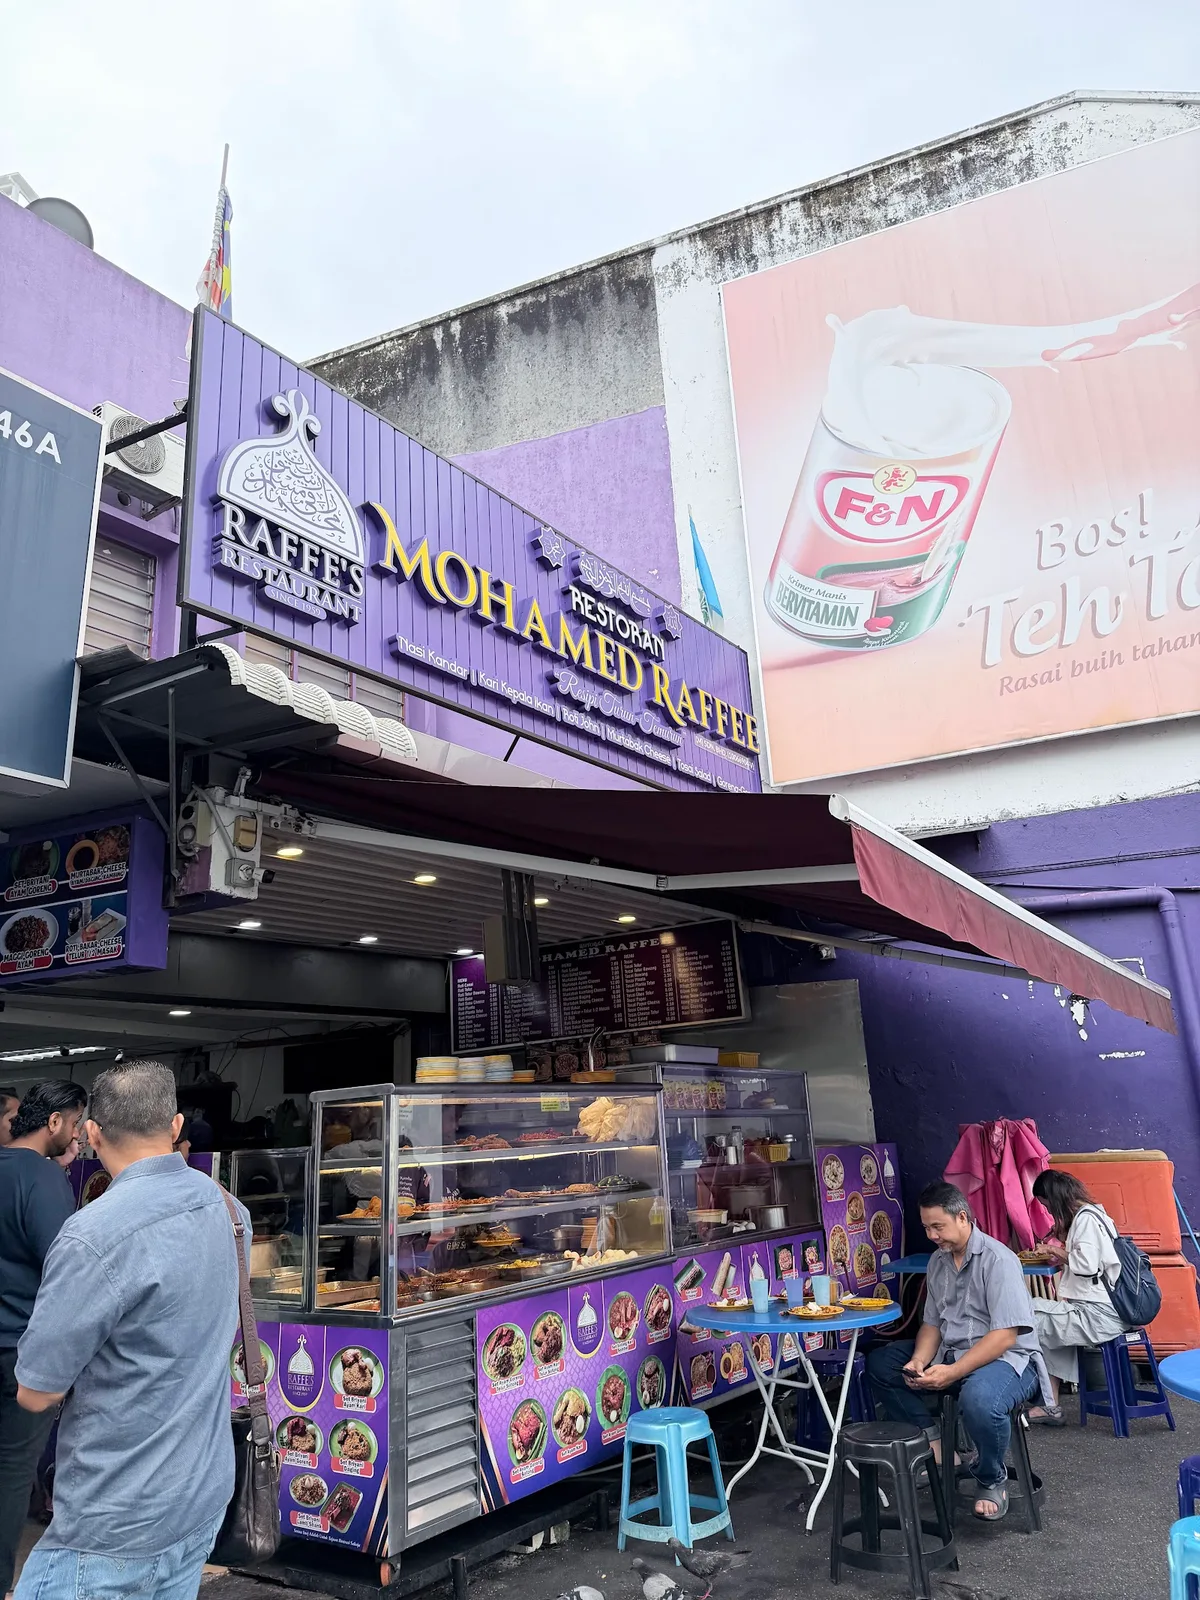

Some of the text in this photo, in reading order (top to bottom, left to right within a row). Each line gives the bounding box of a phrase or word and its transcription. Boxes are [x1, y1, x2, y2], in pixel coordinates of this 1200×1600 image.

[834, 486, 946, 526] F&N
[1035, 487, 1154, 572] Bos!
[220, 500, 365, 598] RAFFE'S
[220, 545, 364, 623] RESTAURANT
[787, 573, 847, 602] Krimer Manis
[270, 588, 322, 618] SINCE 1959
[775, 583, 860, 628] BERVITAMIN
[370, 500, 761, 755] MOHAMED RAFFEE
[568, 584, 666, 663] RESTORAN
[958, 575, 1128, 670] Teh
[999, 662, 1063, 697] Rasai
[1070, 650, 1125, 678] buih
[398, 635, 426, 658] Nasi
[427, 650, 470, 679] Kandar
[477, 672, 500, 691] Kari
[500, 680, 534, 704] Kepala
[534, 696, 554, 718] Ikan
[562, 707, 579, 724] Roti
[580, 714, 600, 735] John
[606, 724, 644, 755] Murtabak
[644, 744, 672, 766] Cheese
[676, 757, 695, 774] Tosai
[694, 766, 712, 783] Salad
[102, 861, 126, 875] CHEESE
[9, 881, 52, 899] AYAM GORENG
[25, 948, 49, 960] GORENG
[65, 936, 122, 953] ROTI BAKAR CHEESE
[68, 950, 85, 960] TELUR
[96, 944, 118, 956] MASAK
[541, 947, 600, 963] HAMED
[605, 937, 661, 954] RAFFE
[16, 959, 34, 970] AYAM
[344, 1466, 360, 1474] Daging
[348, 1460, 364, 1468] Briyani
